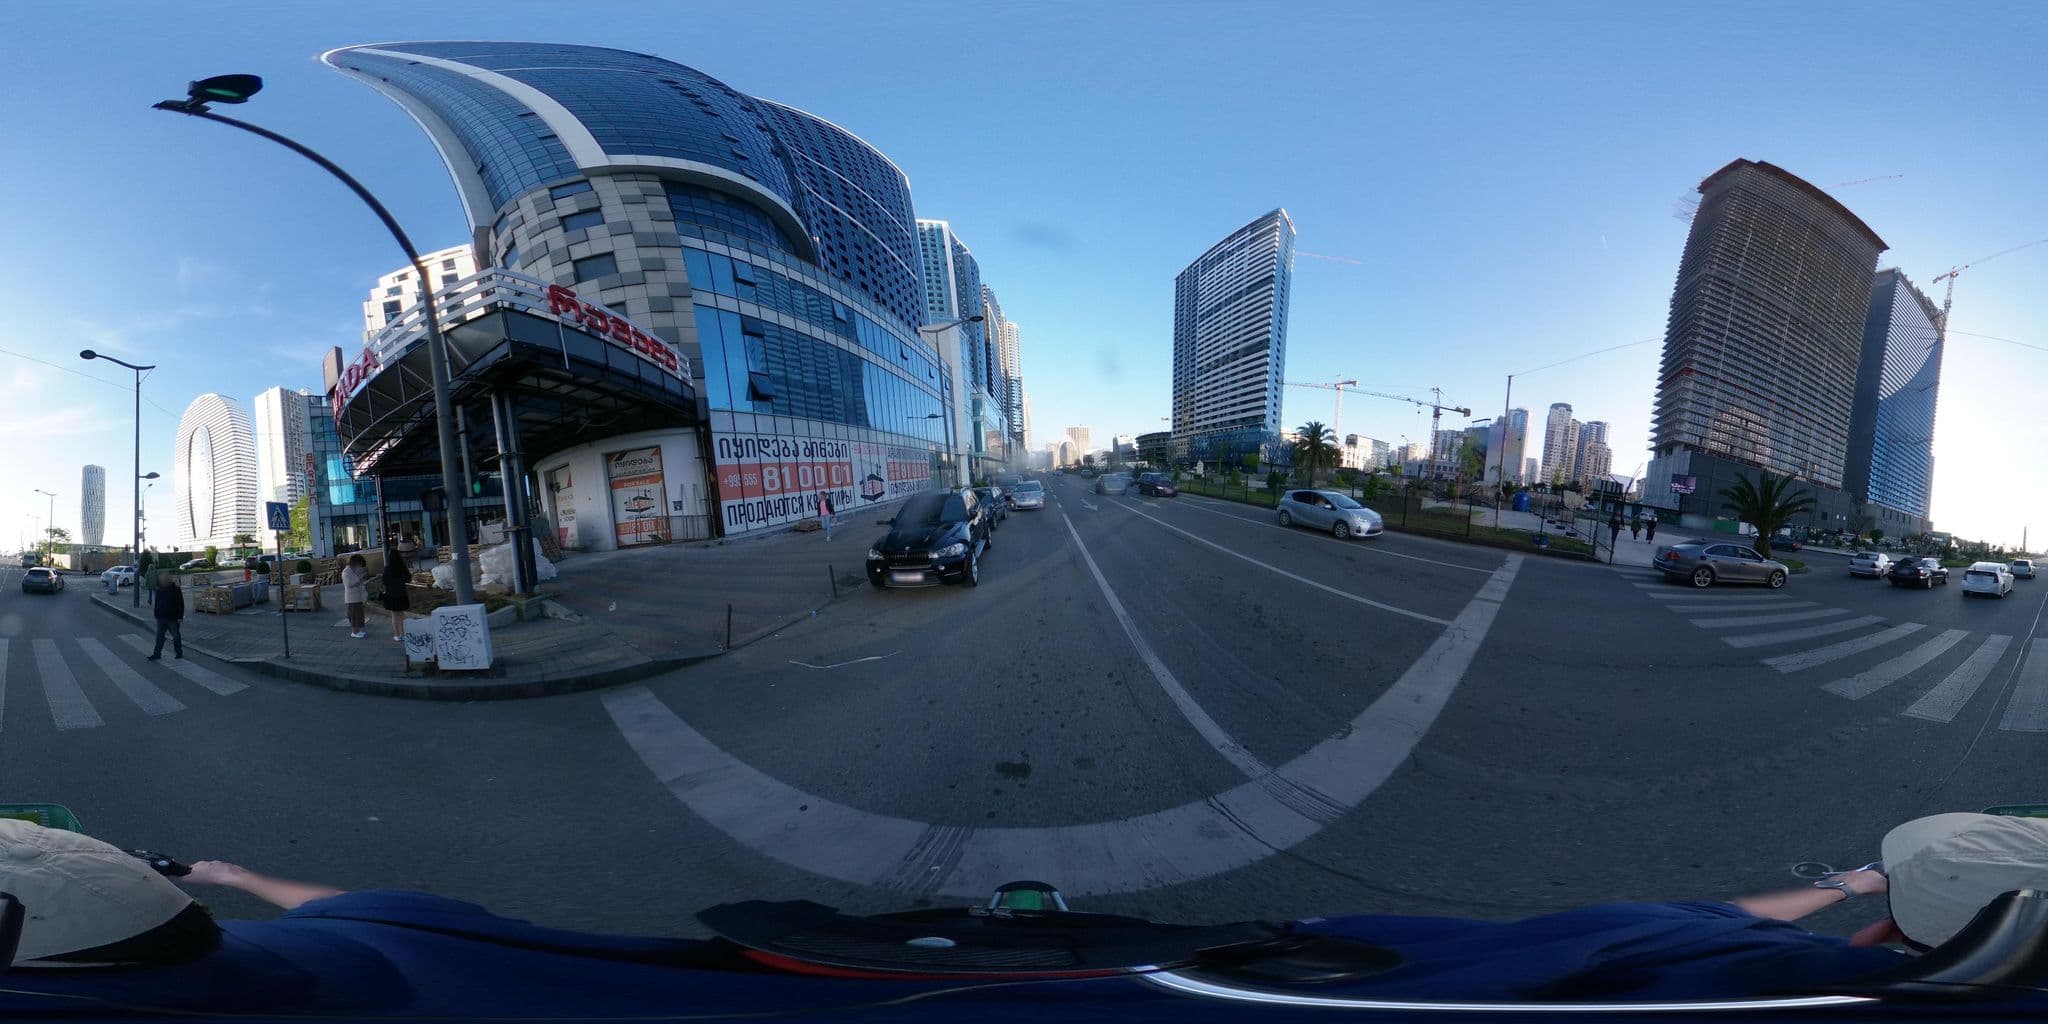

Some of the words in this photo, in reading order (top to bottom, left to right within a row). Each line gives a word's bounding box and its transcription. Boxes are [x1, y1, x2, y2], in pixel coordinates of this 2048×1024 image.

[718, 438, 800, 459] იყიდება
[802, 440, 848, 458] ბინები
[762, 466, 793, 491] 81
[798, 465, 826, 488] 00
[831, 464, 851, 485] 01
[727, 495, 804, 526] ПРОДАЮТСЯ
[806, 489, 853, 511] КВТИРЫ
